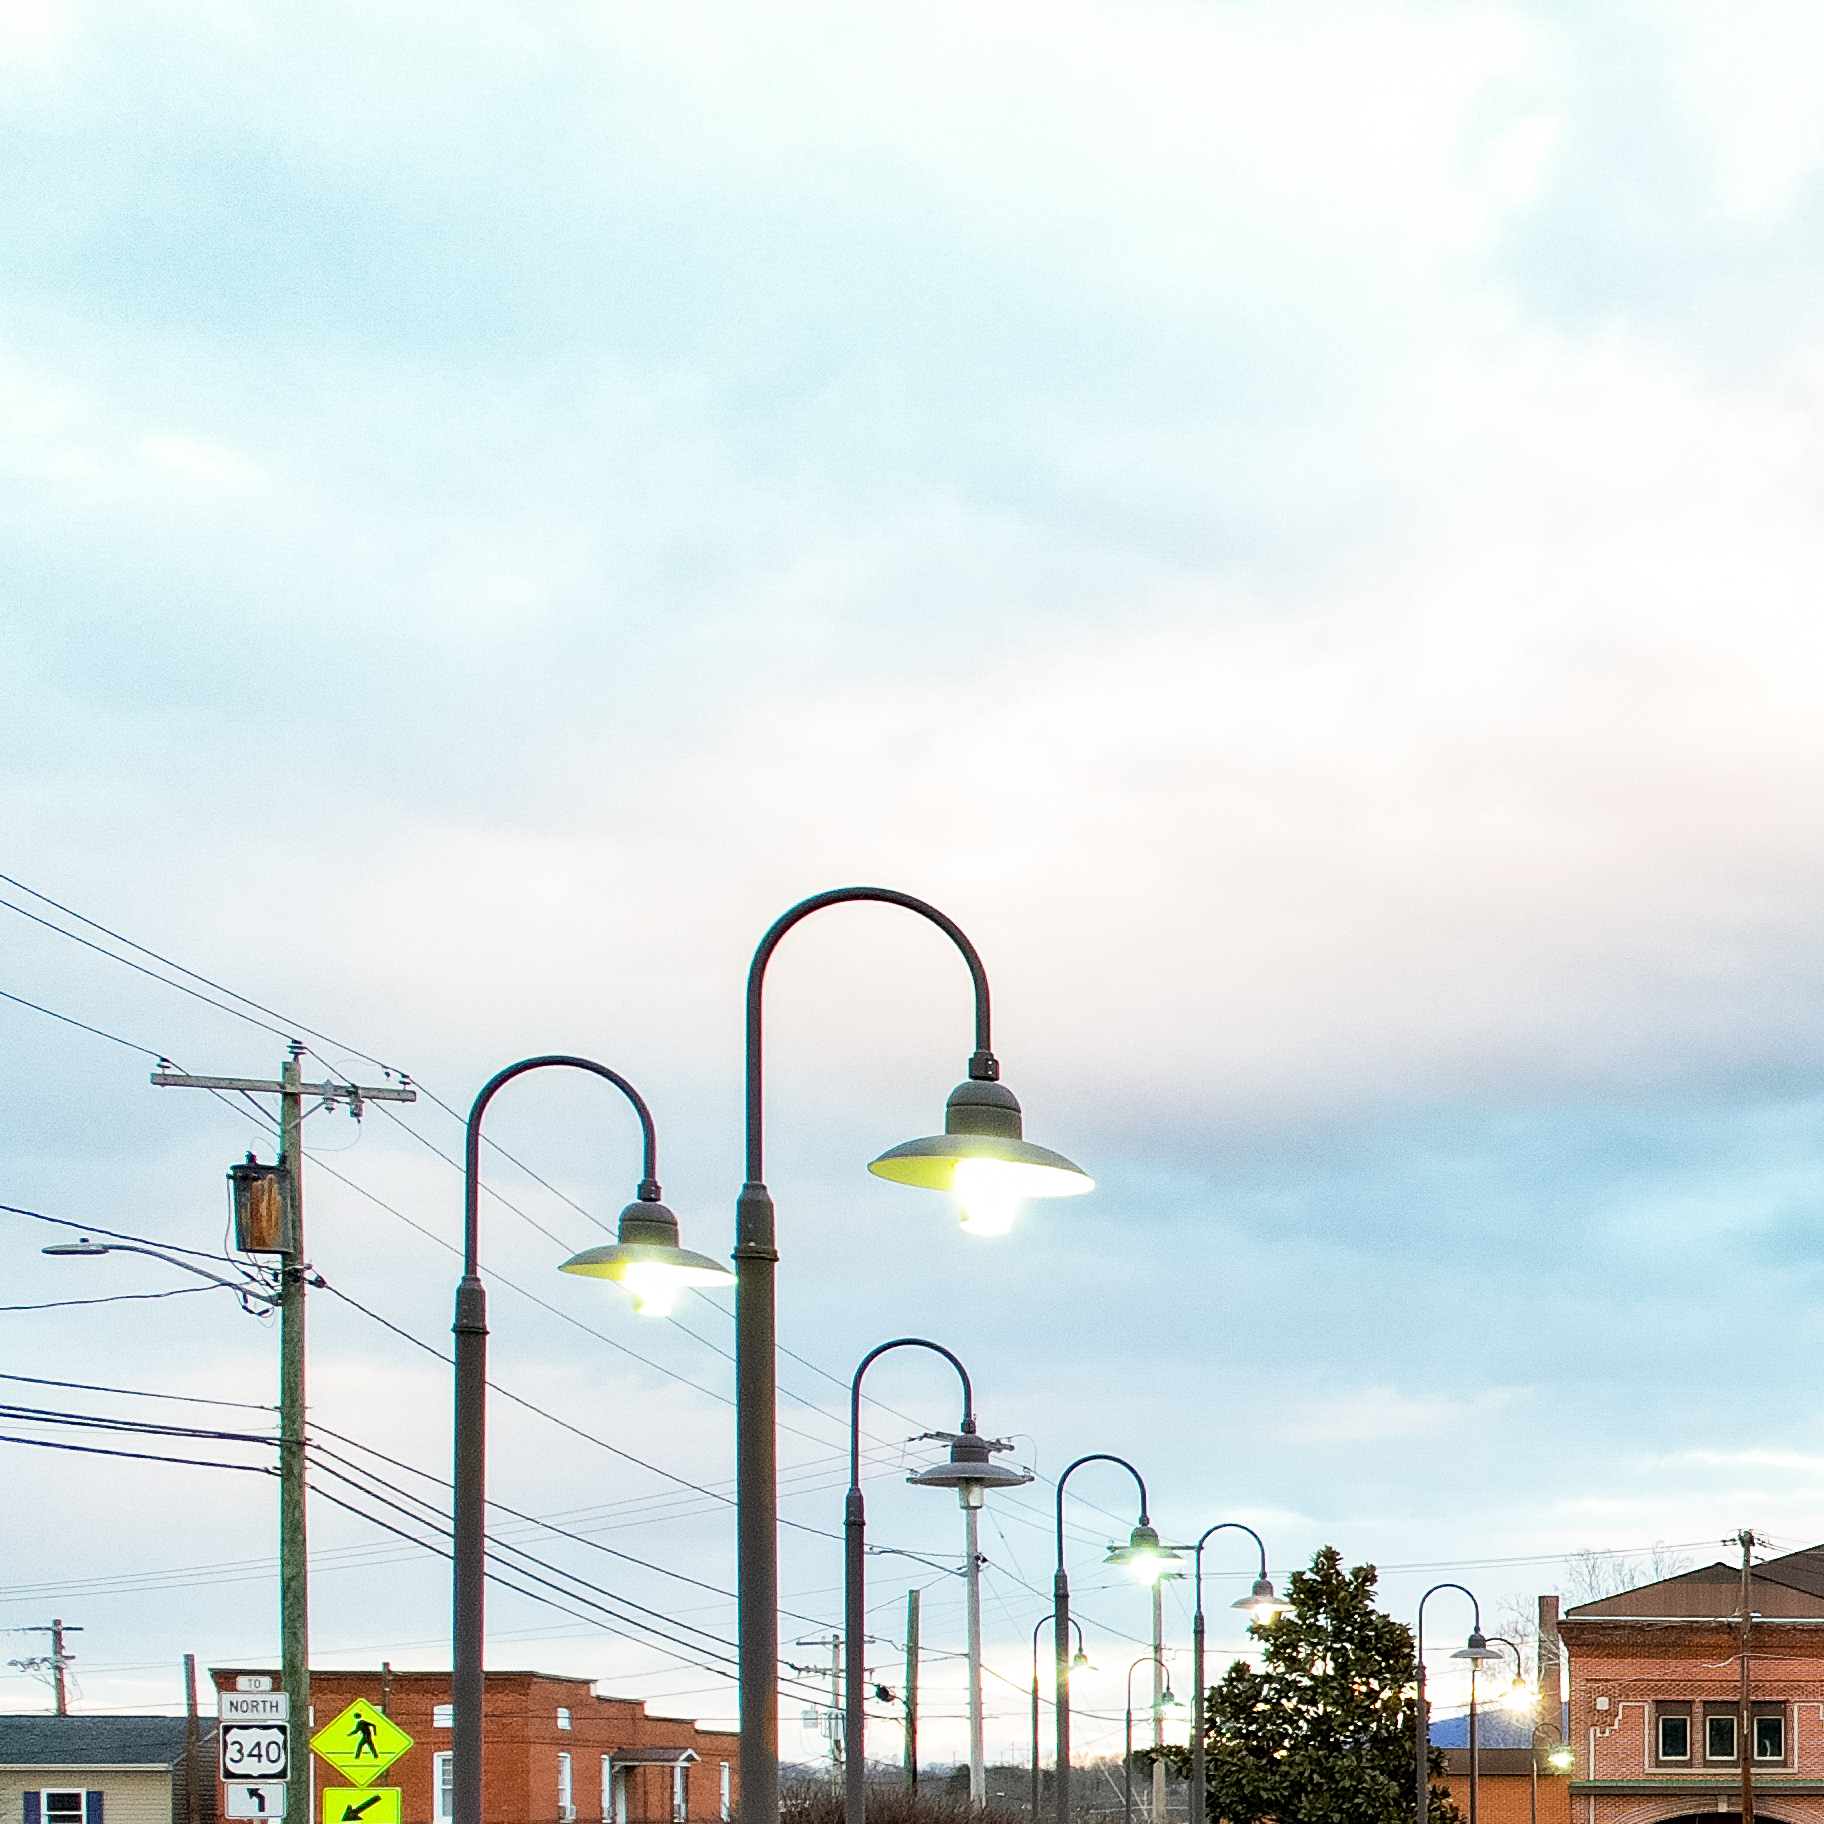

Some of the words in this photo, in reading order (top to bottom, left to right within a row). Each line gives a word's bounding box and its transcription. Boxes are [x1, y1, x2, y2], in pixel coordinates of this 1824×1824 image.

[247, 1678, 261, 1689] TO
[229, 1699, 279, 1713] NORTH
[229, 1740, 281, 1764] 340
